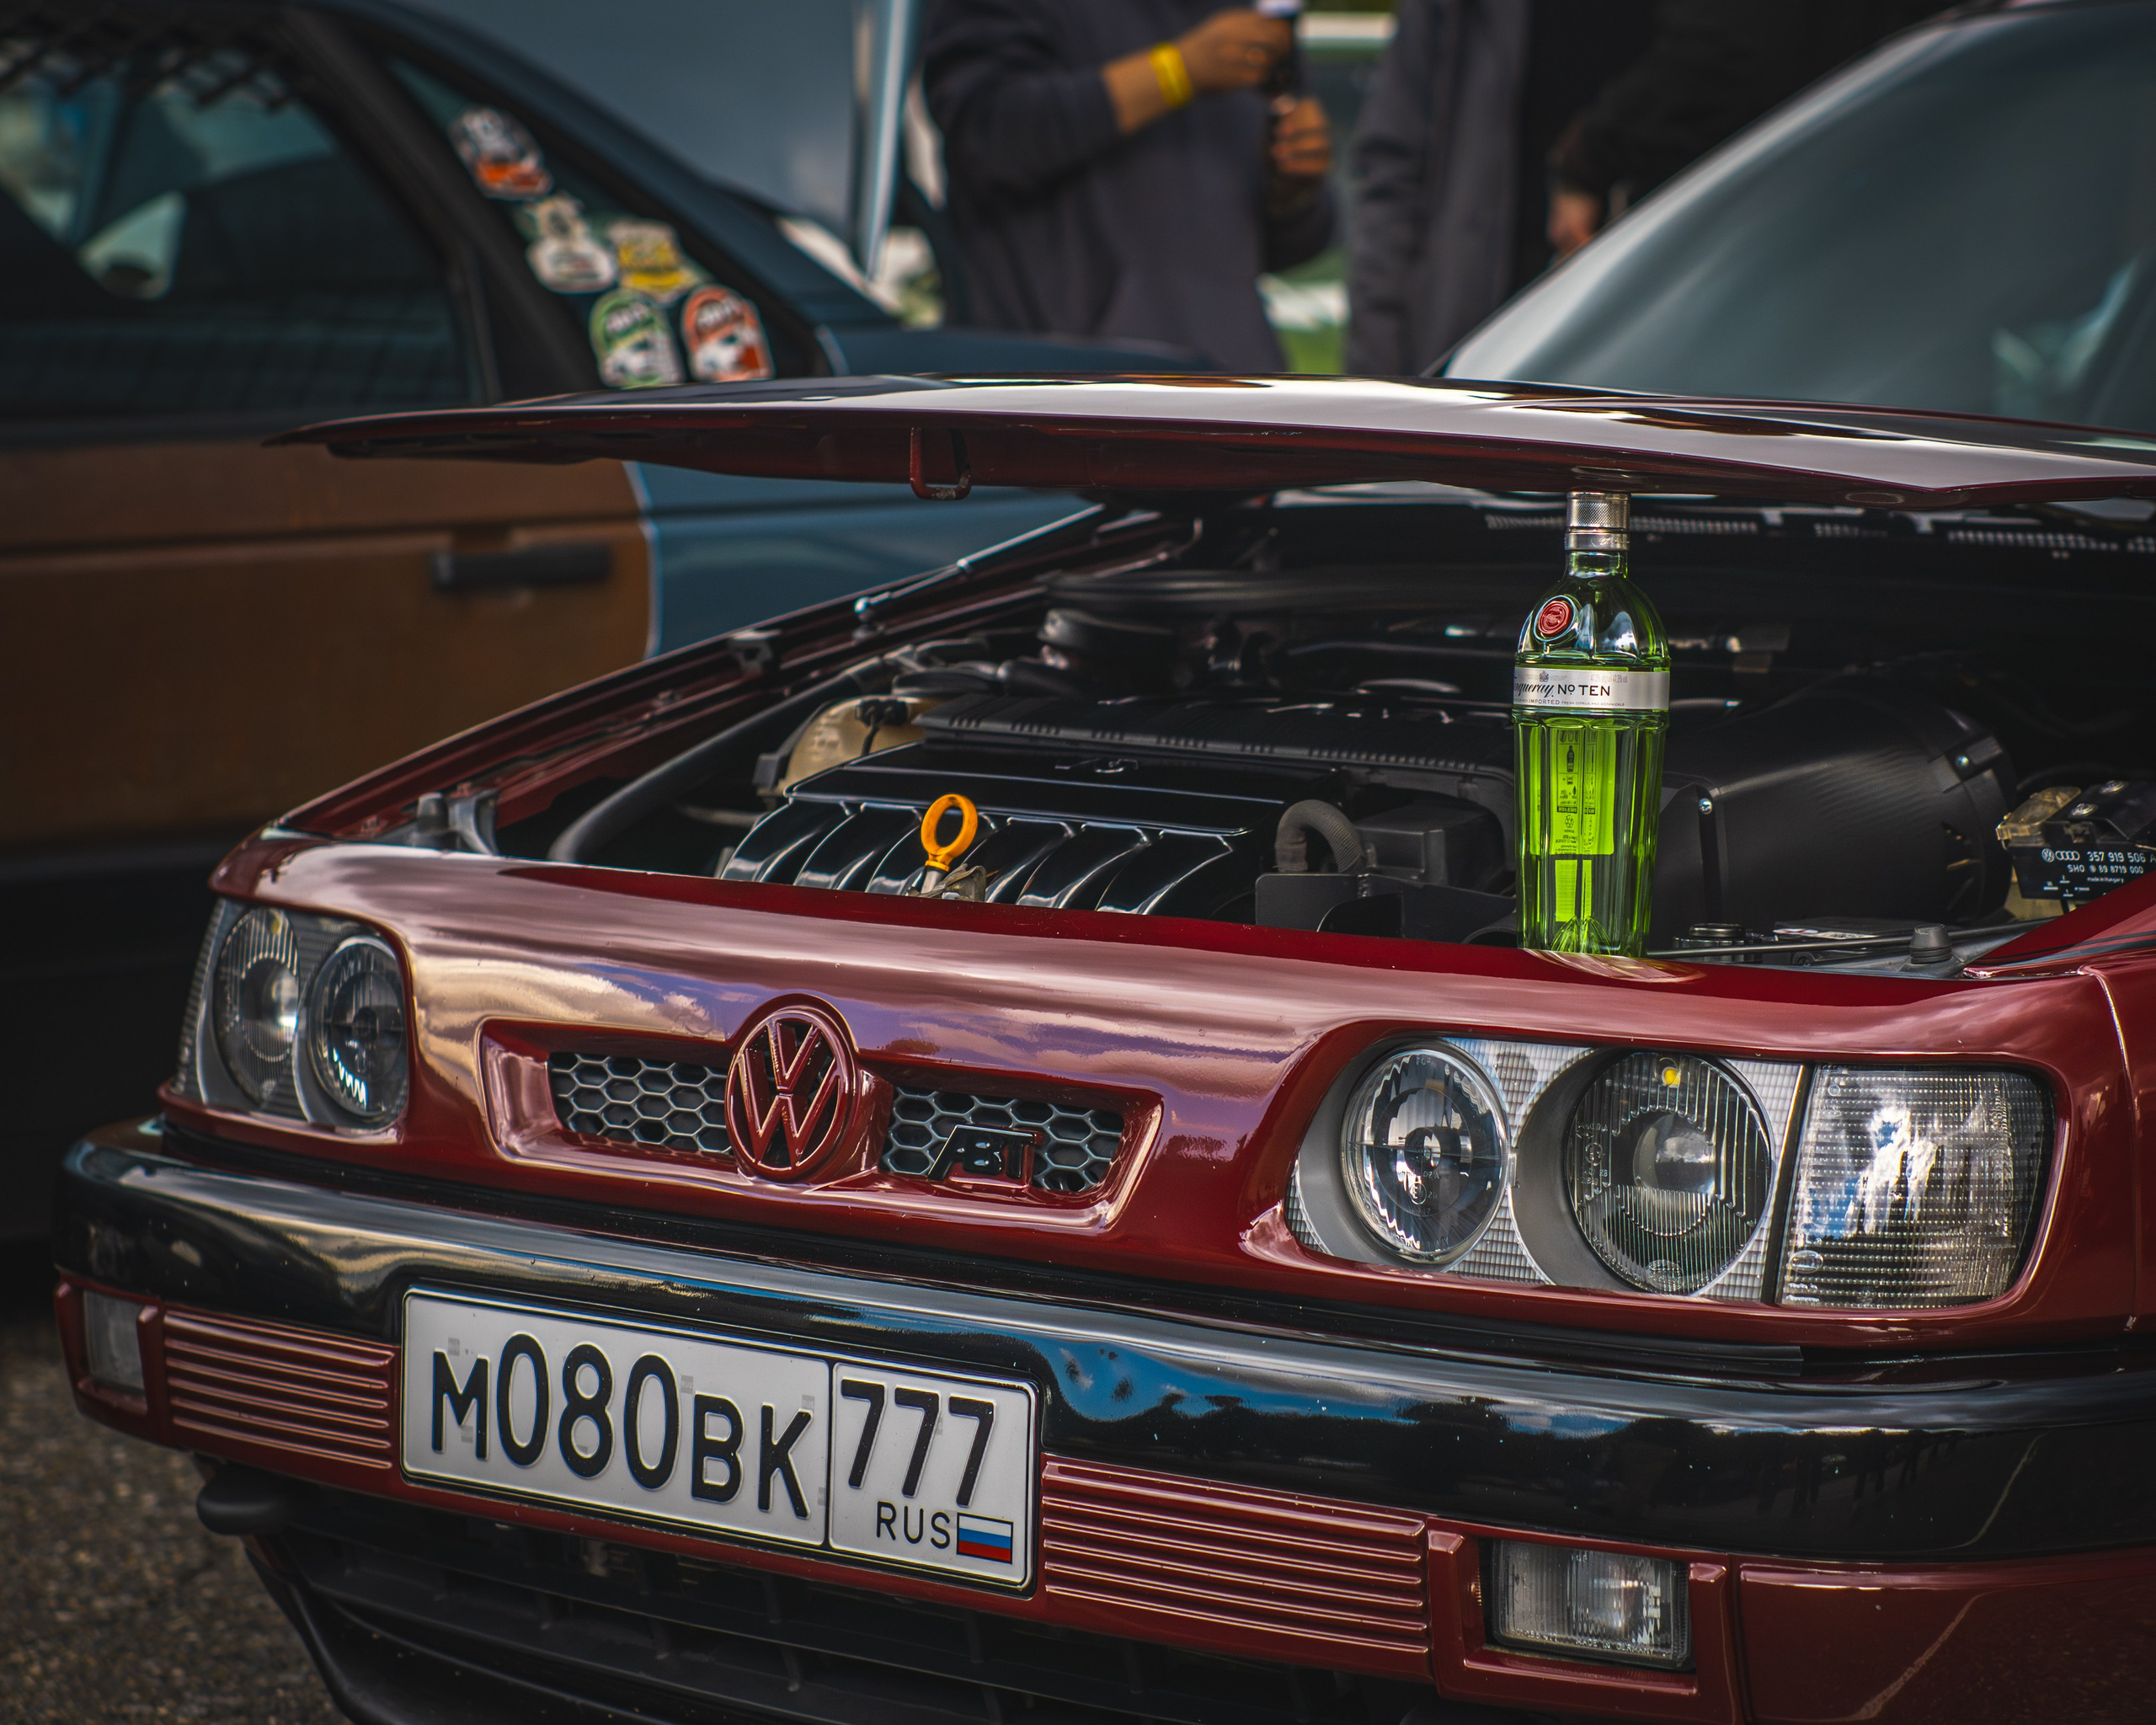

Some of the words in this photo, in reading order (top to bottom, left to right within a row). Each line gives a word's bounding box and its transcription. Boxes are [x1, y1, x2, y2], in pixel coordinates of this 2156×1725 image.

[1578, 685, 1610, 697] TEN
[2087, 851, 2105, 862] 357
[2108, 852, 2125, 862] 919
[2127, 852, 2146, 863] 506
[2110, 865, 2127, 873] 8719
[2129, 865, 2144, 874] 000
[926, 1124, 1034, 1181] ABT
[431, 1332, 812, 1520] M080BK
[840, 1378, 995, 1508] 777
[877, 1501, 951, 1550] RUS
[1576, 1638, 1598, 1648] MADE
[1616, 1642, 1654, 1655] GERMANY
